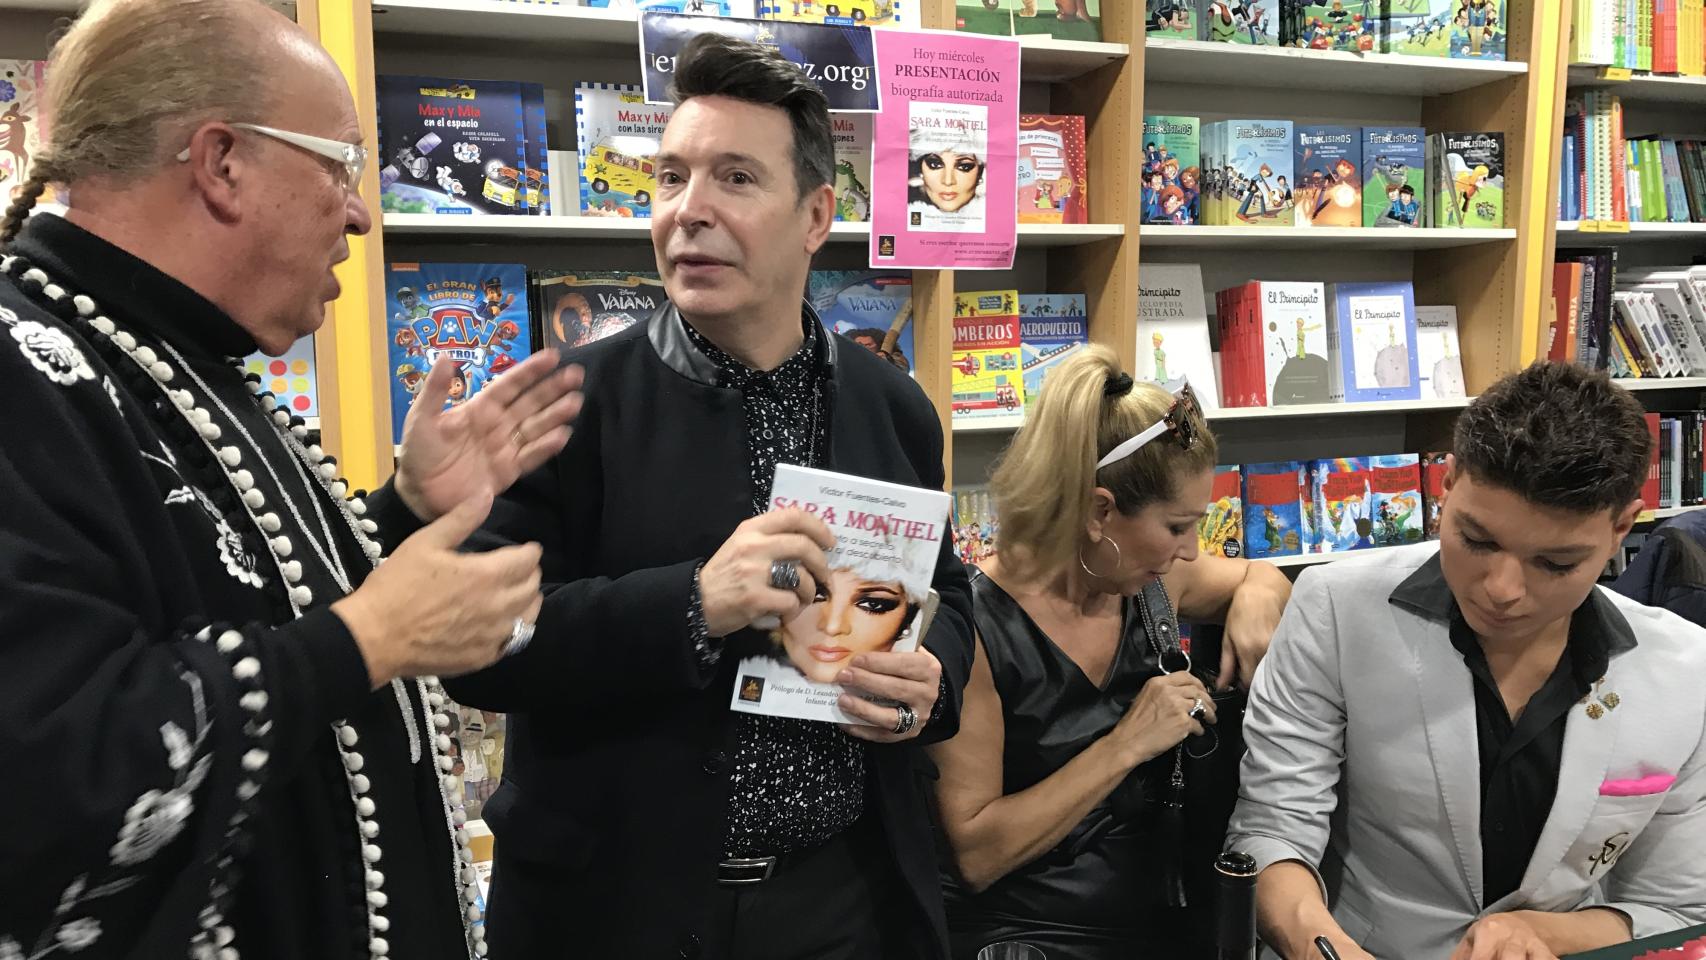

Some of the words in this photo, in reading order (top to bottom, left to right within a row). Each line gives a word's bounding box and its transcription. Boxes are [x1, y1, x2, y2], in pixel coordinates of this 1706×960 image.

[913, 47, 935, 62] Hoy
[938, 50, 985, 64] miércoles
[795, 62, 867, 90] z.org
[894, 64, 1000, 83] PRESENTACIÓN
[891, 82, 944, 100] biografía
[946, 89, 1004, 103] autorizada
[418, 104, 445, 116] Max
[447, 107, 455, 119] y
[618, 110, 642, 122] Max
[645, 114, 651, 125] y
[653, 112, 671, 123] Mi
[424, 119, 435, 127] en
[437, 117, 445, 127] el
[446, 118, 479, 130] espacio
[618, 125, 632, 133] con
[634, 124, 646, 133] las
[647, 125, 666, 134] sire
[910, 116, 941, 129] SARA
[945, 118, 987, 131] MONTIEL
[832, 135, 855, 144] gones
[426, 282, 438, 291] EL
[442, 281, 476, 291] GRAN
[618, 288, 637, 297] Disney
[428, 291, 459, 301] LIBRO
[462, 291, 476, 301] DE
[597, 293, 656, 311] VAIANA
[1268, 291, 1278, 304] El
[1279, 291, 1318, 306] Principito
[848, 297, 896, 312] VAIANA
[1354, 309, 1362, 320] El
[1365, 308, 1401, 320] Principito
[411, 315, 498, 349] PAW
[952, 323, 1014, 342] MBEROS
[1020, 322, 1081, 336] AEROPUERTO
[433, 349, 479, 360] PTROL
[844, 509, 938, 542] MONTIEL
[770, 684, 795, 696] Prólogo
[813, 689, 839, 698] Leandro
[805, 697, 828, 706] Infante
